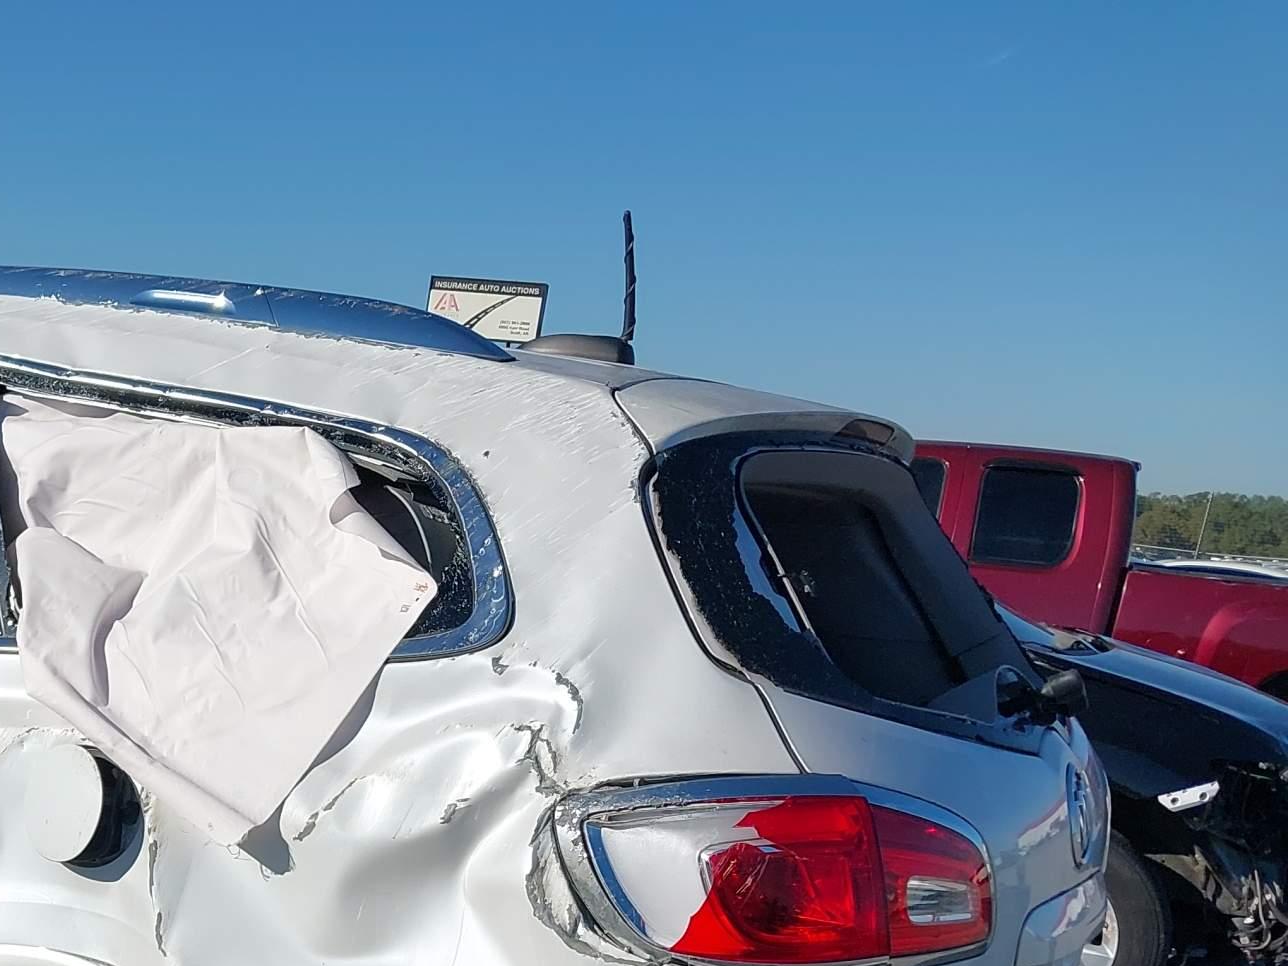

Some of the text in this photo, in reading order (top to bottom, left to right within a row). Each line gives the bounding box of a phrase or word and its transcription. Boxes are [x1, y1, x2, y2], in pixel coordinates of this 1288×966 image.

[434, 281, 540, 295] INSURANCE AUTO AUCTIONS
